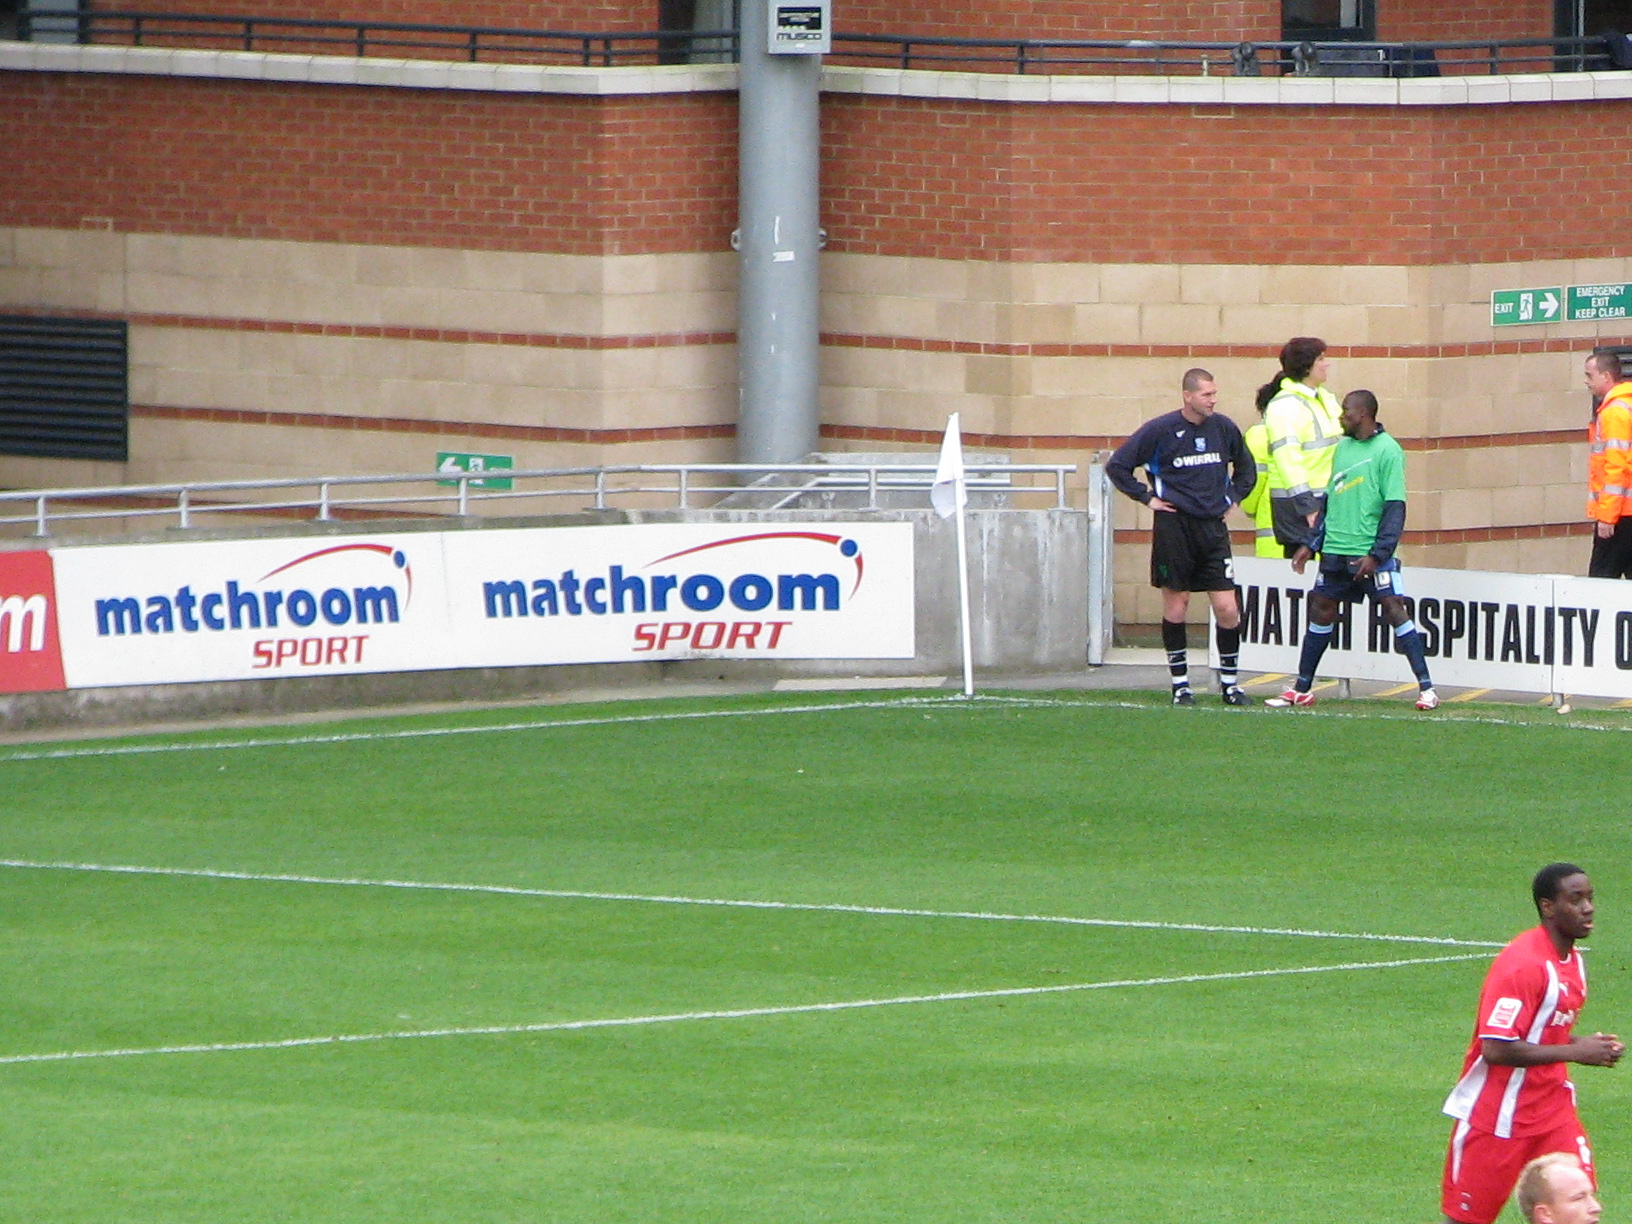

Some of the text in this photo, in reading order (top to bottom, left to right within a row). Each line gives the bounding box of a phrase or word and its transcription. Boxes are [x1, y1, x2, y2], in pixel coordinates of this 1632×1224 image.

[1576, 285, 1625, 297] EMERGENCY
[1591, 296, 1610, 307] EXIT
[1494, 302, 1514, 314] EXIT
[1575, 306, 1626, 319] KEEP CLEAR
[482, 565, 841, 619] matchroom
[95, 580, 400, 637] matchroom
[632, 621, 793, 652] SPORT
[252, 635, 370, 668] SPORT
